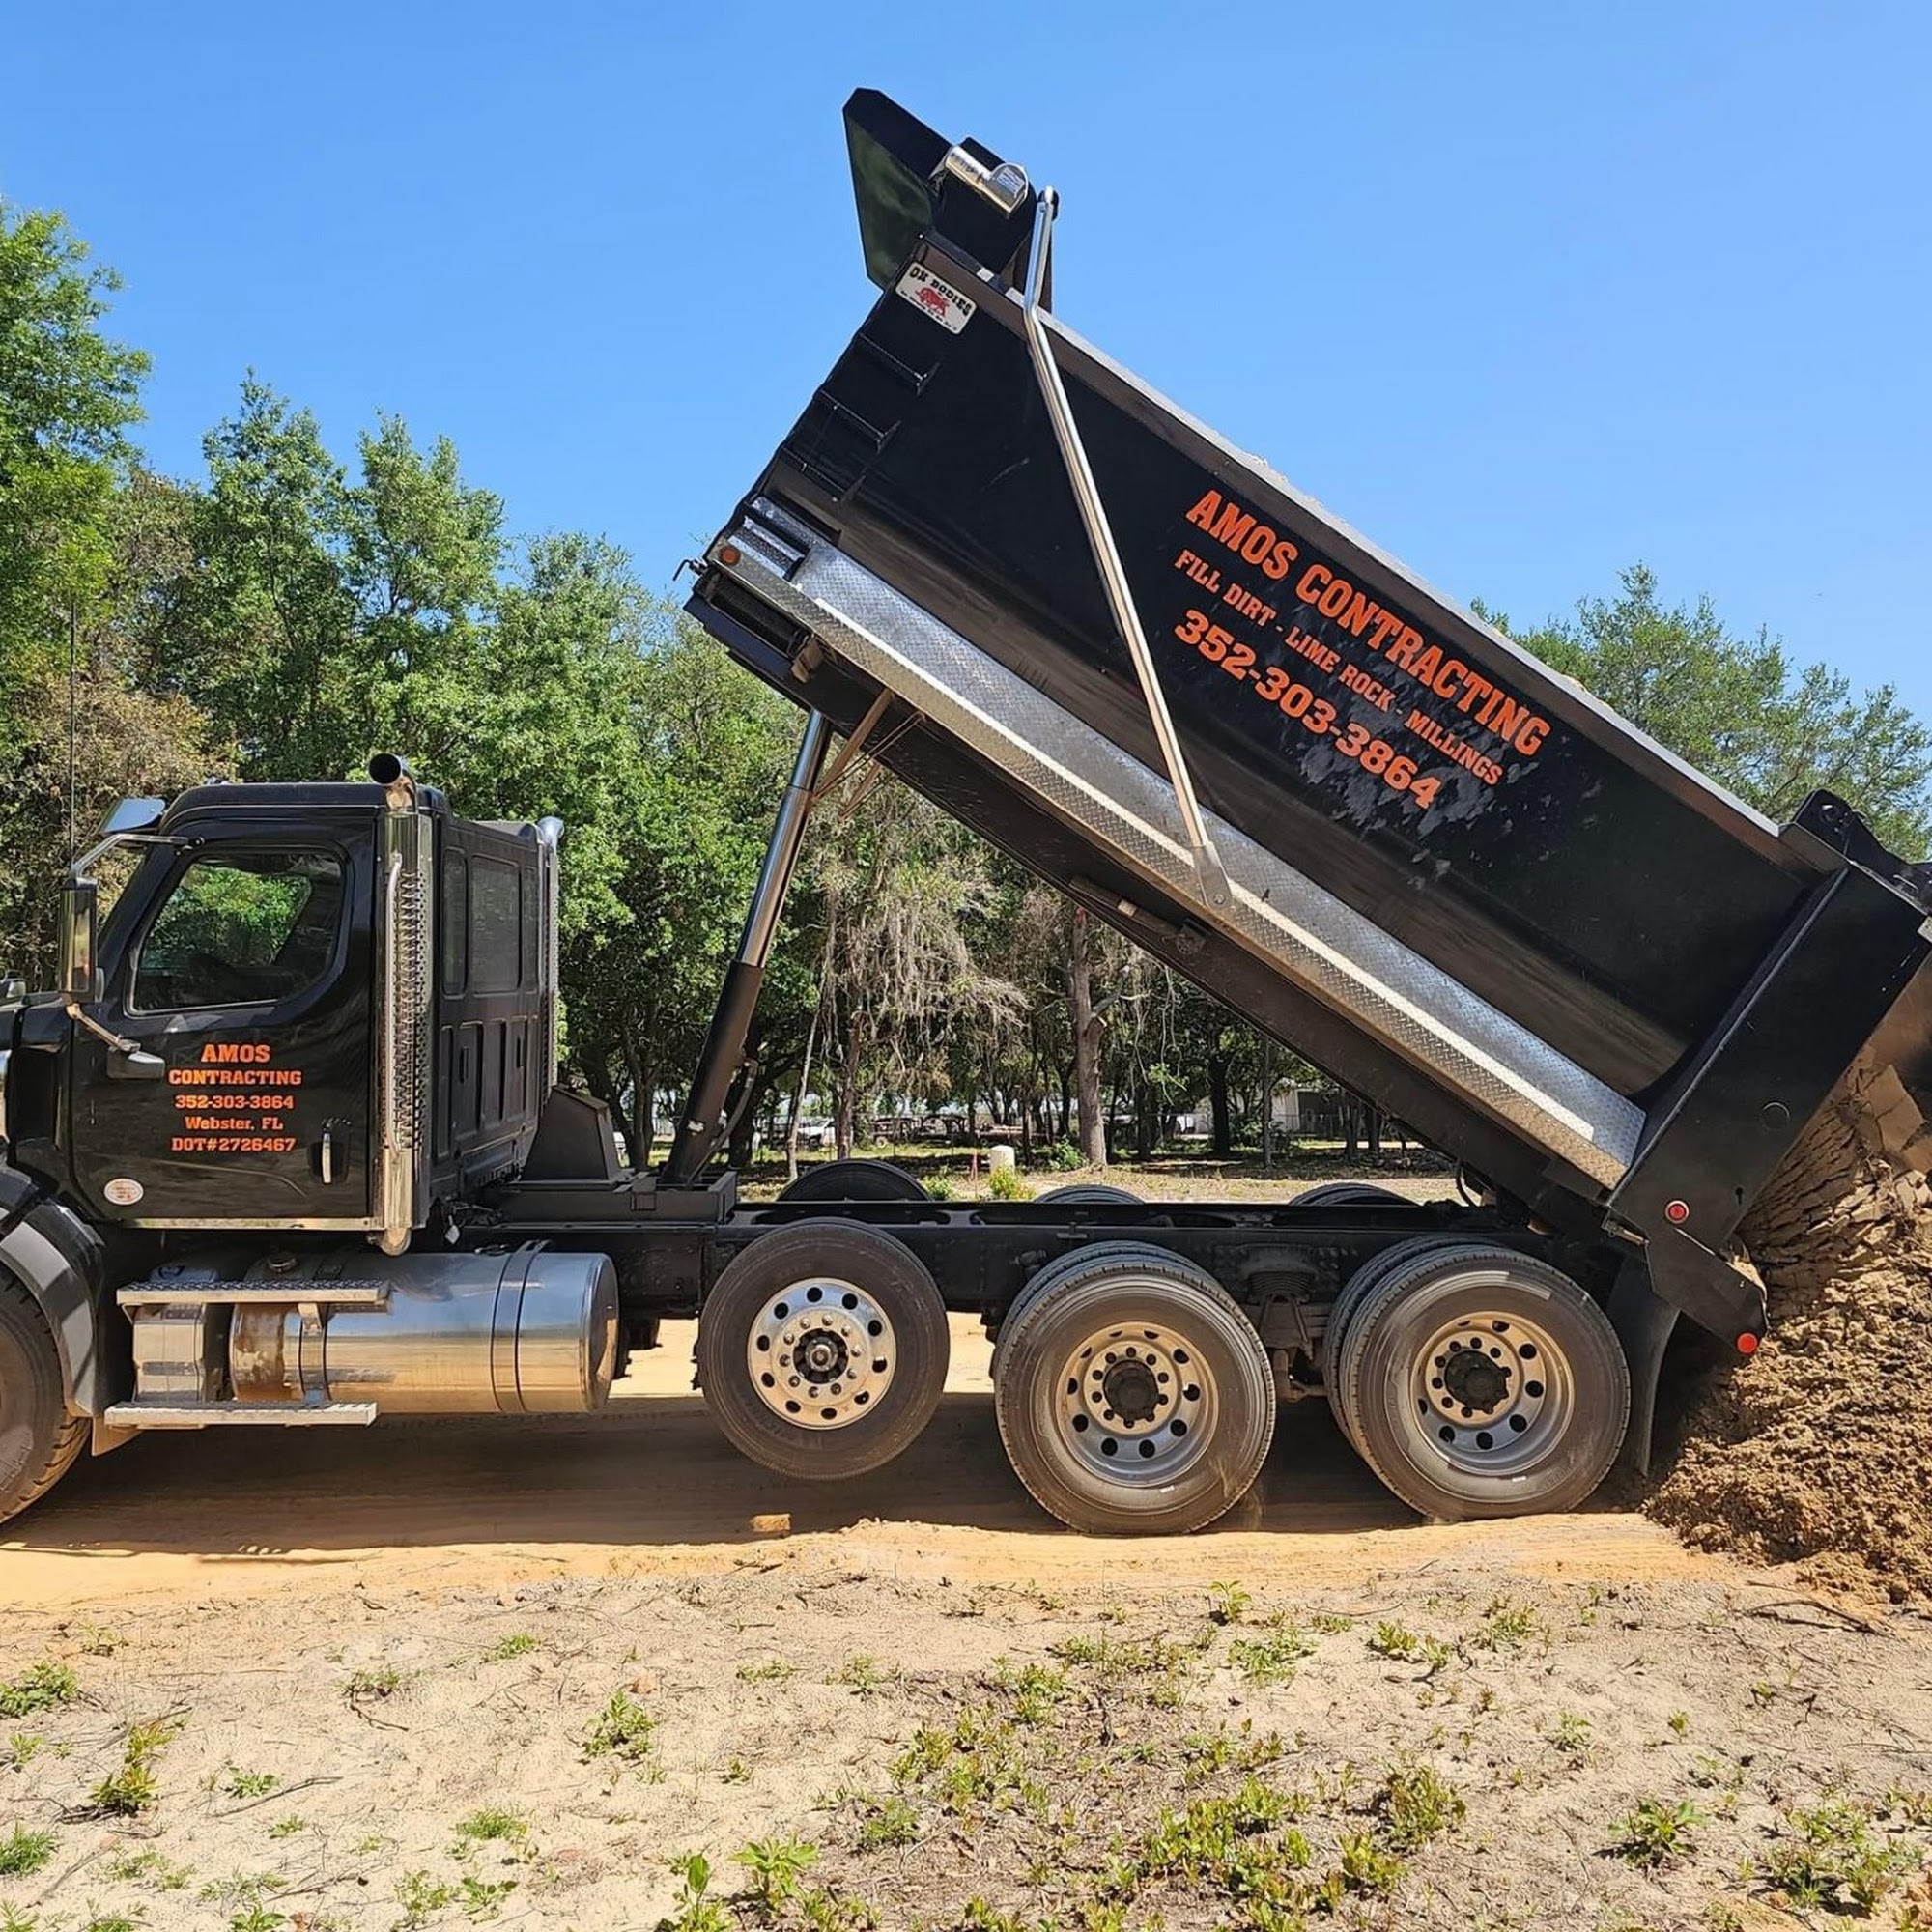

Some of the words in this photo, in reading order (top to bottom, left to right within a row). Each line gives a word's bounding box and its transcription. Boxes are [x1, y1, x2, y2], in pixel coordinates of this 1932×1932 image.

[930, 278, 972, 317] BODIES
[1186, 489, 1299, 581] AMOS
[1295, 563, 1552, 757] CONTRACTING
[1173, 550, 1221, 594] FILL
[1222, 582, 1276, 627] DIRT
[1275, 623, 1284, 633] -
[1285, 626, 1340, 673] LIME
[1339, 664, 1398, 714] ROCK
[1404, 708, 1504, 786] MILLINGS
[1174, 609, 1442, 810] 352-303-3864
[200, 1043, 270, 1064] AMOS
[168, 1068, 302, 1086] CONTRACTING
[174, 1094, 295, 1110] 352-303-3864
[261, 1116, 284, 1130] FL
[171, 1137, 297, 1152] DOT#2726467
